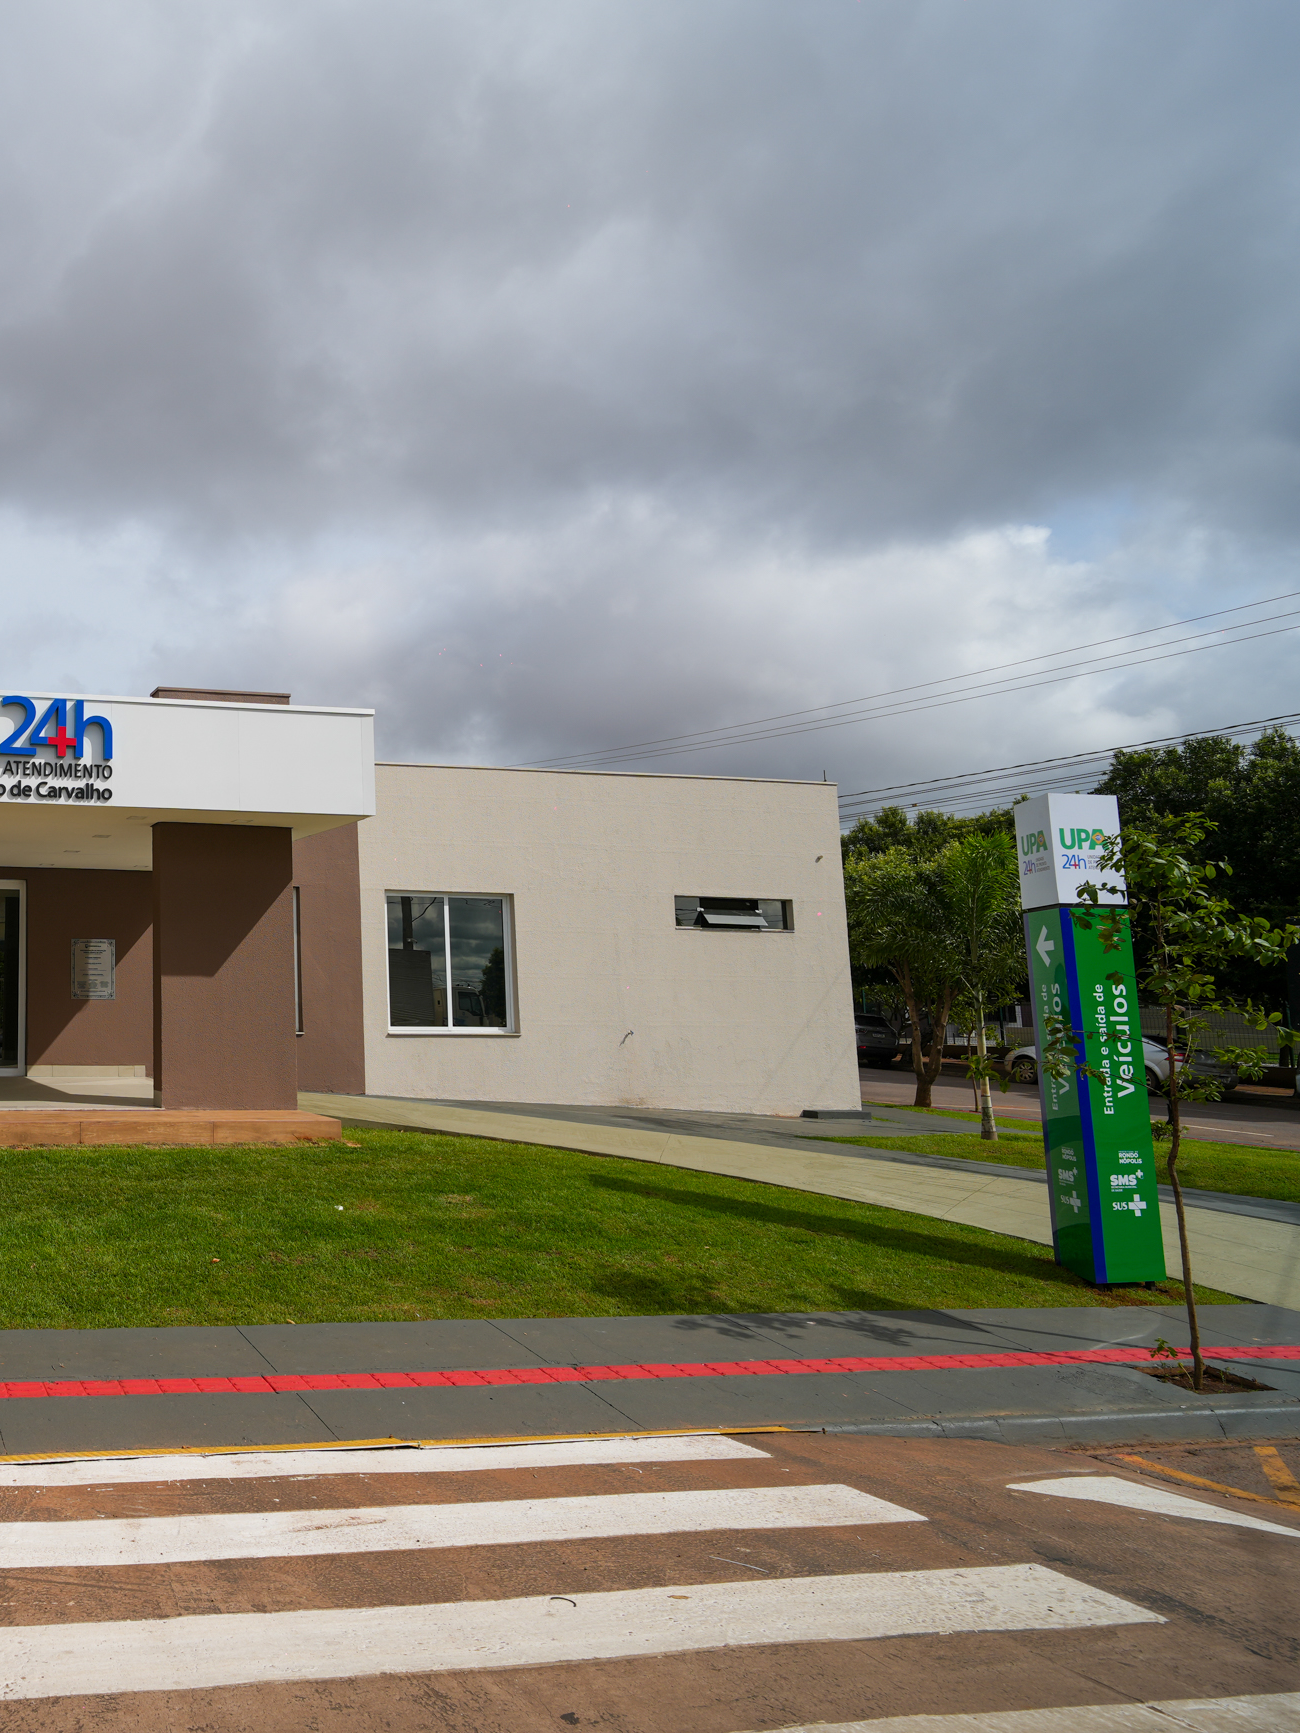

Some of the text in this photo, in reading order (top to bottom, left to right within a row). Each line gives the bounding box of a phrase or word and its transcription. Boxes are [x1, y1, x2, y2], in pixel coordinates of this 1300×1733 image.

[2, 759, 113, 780] ATENDIMENTO
[9, 780, 33, 798] de
[34, 781, 113, 802] Carvalho
[1021, 830, 1048, 857] UPA
[1059, 828, 1110, 851] UPA
[1023, 859, 1036, 876] 24h
[1061, 854, 1087, 870] 24h
[1041, 984, 1048, 1001] de
[1093, 984, 1115, 1115] Entrada e saída de
[1109, 984, 1135, 1098] Veículos
[1058, 1168, 1074, 1182] SMS
[1110, 1174, 1137, 1186] SMS
[1060, 1194, 1070, 1205] SUS
[1112, 1202, 1128, 1210] SUS
